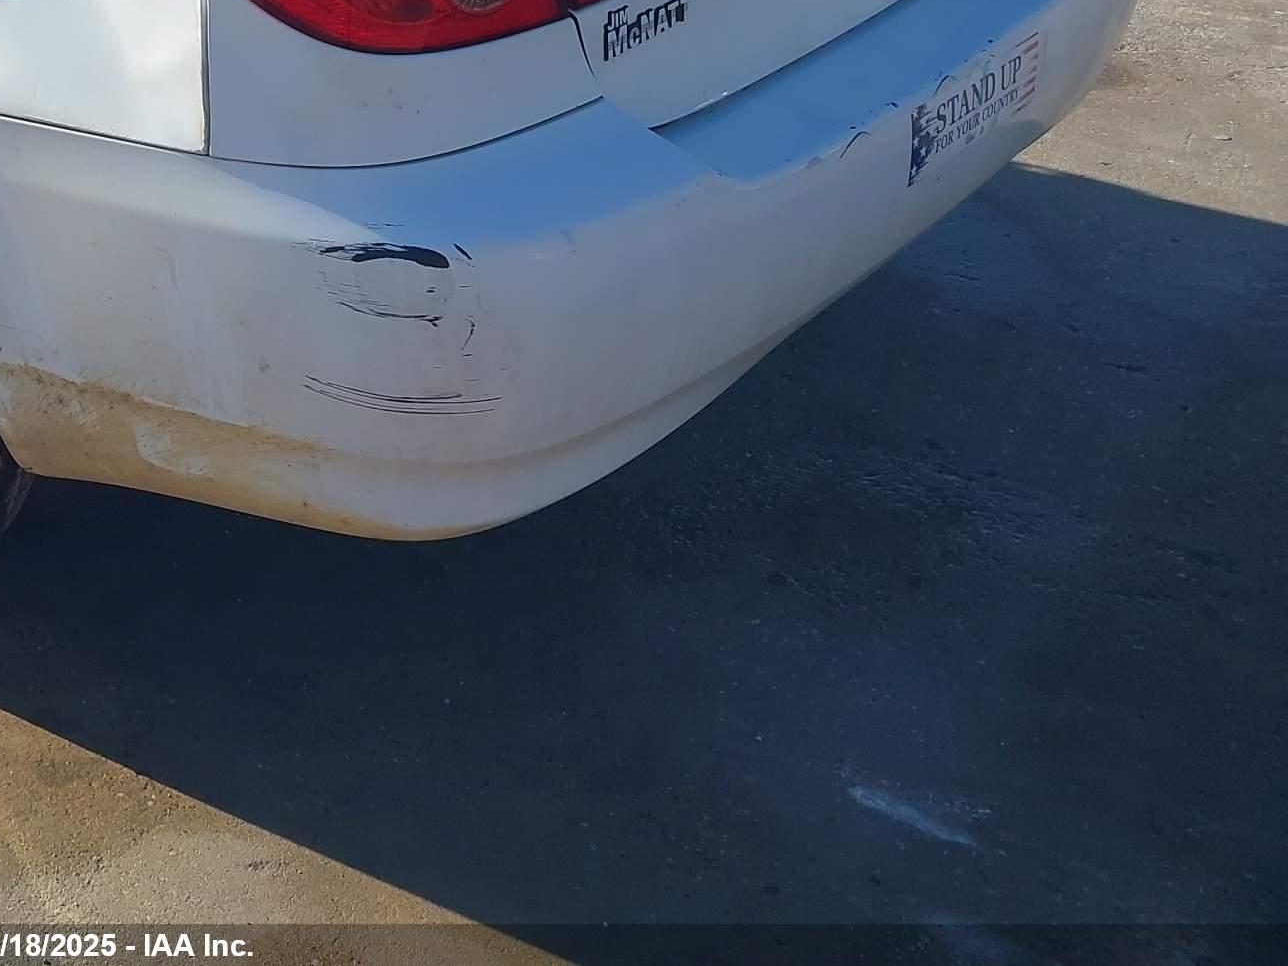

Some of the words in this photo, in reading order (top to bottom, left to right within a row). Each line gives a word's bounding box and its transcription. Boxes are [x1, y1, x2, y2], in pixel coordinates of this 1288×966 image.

[608, 5, 630, 31] JIM
[935, 72, 996, 135] STAND
[1000, 55, 1022, 91] UP
[935, 131, 955, 154] FOR
[956, 113, 981, 140] YOUR
[982, 87, 1019, 122] COUNTRY
